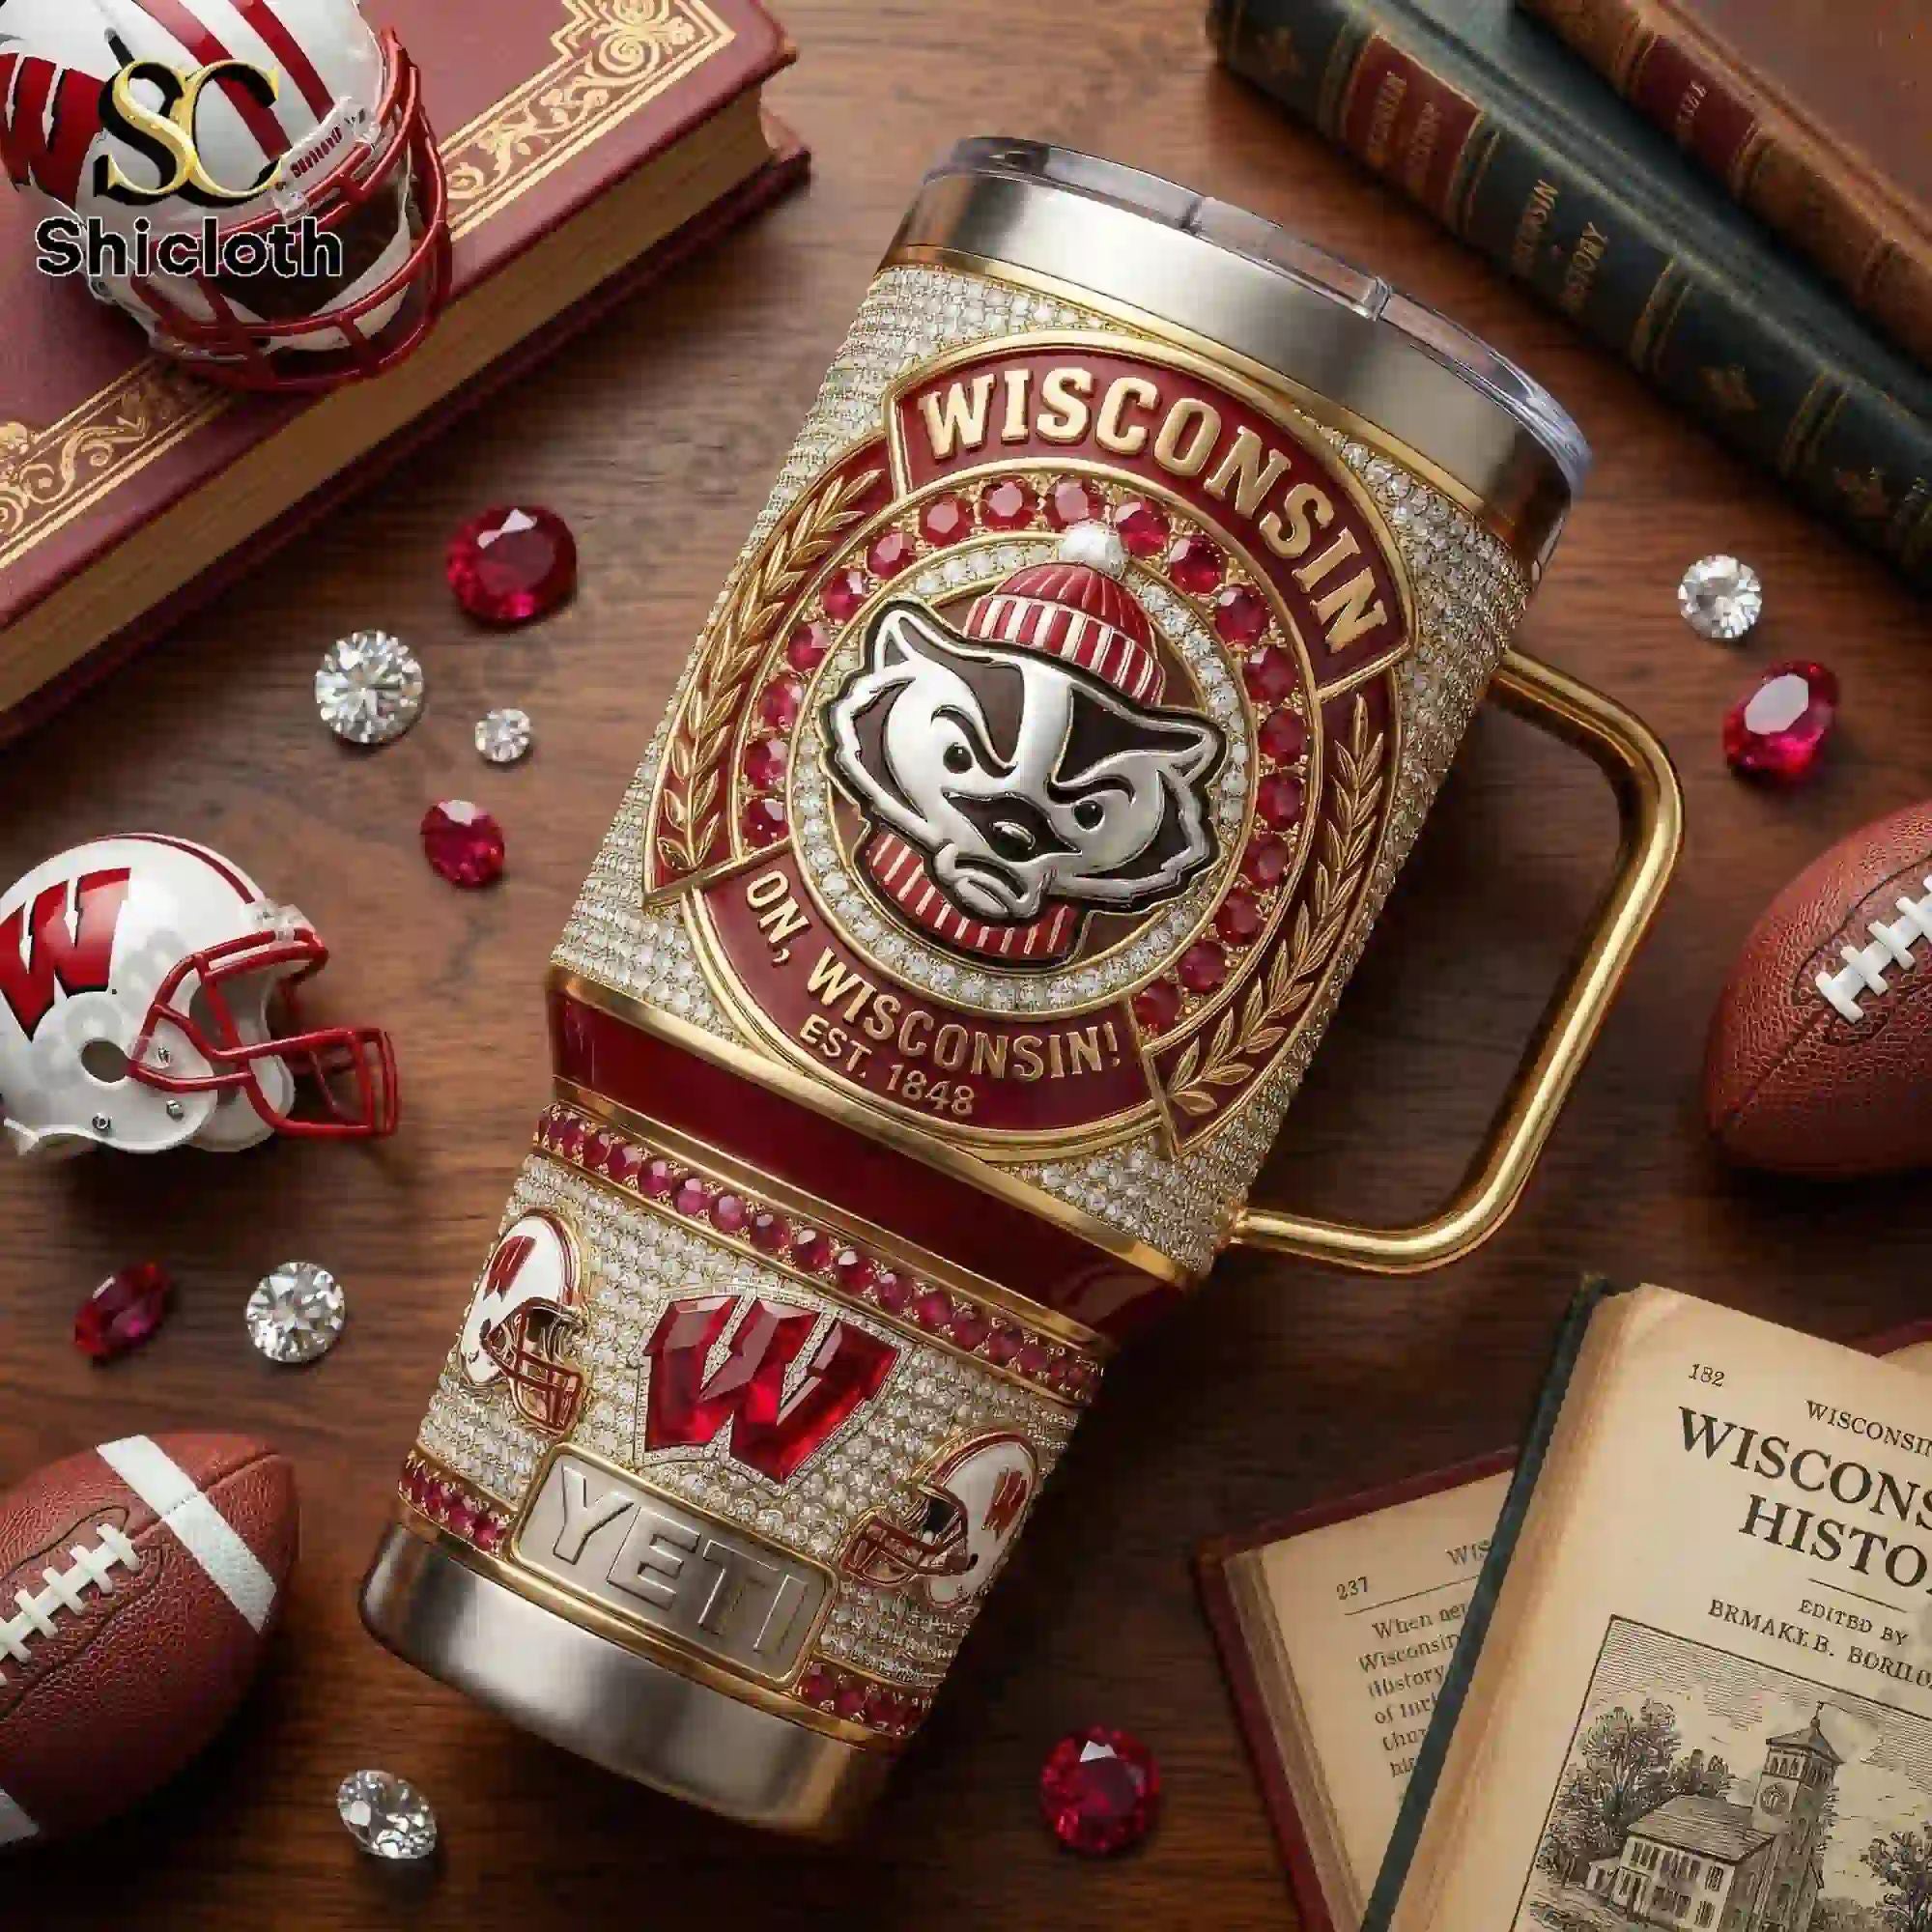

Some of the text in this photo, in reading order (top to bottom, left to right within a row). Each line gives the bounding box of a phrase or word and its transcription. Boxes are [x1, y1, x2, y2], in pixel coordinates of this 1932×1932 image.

[918, 367, 1388, 654] WISCONSIN
[0, 867, 132, 1043] W
[746, 869, 1122, 1080] ON, WISCONSIN!
[800, 1012, 976, 1117] EST. 1848
[640, 1293, 906, 1485] W
[1689, 1363, 1726, 1388] 182
[553, 1463, 810, 1653] YETI
[1336, 1576, 1370, 1601] 237
[1739, 1493, 1932, 1596] HISTO
[1371, 1612, 1434, 1639] When
[1798, 1599, 1910, 1646] EDITED BY
